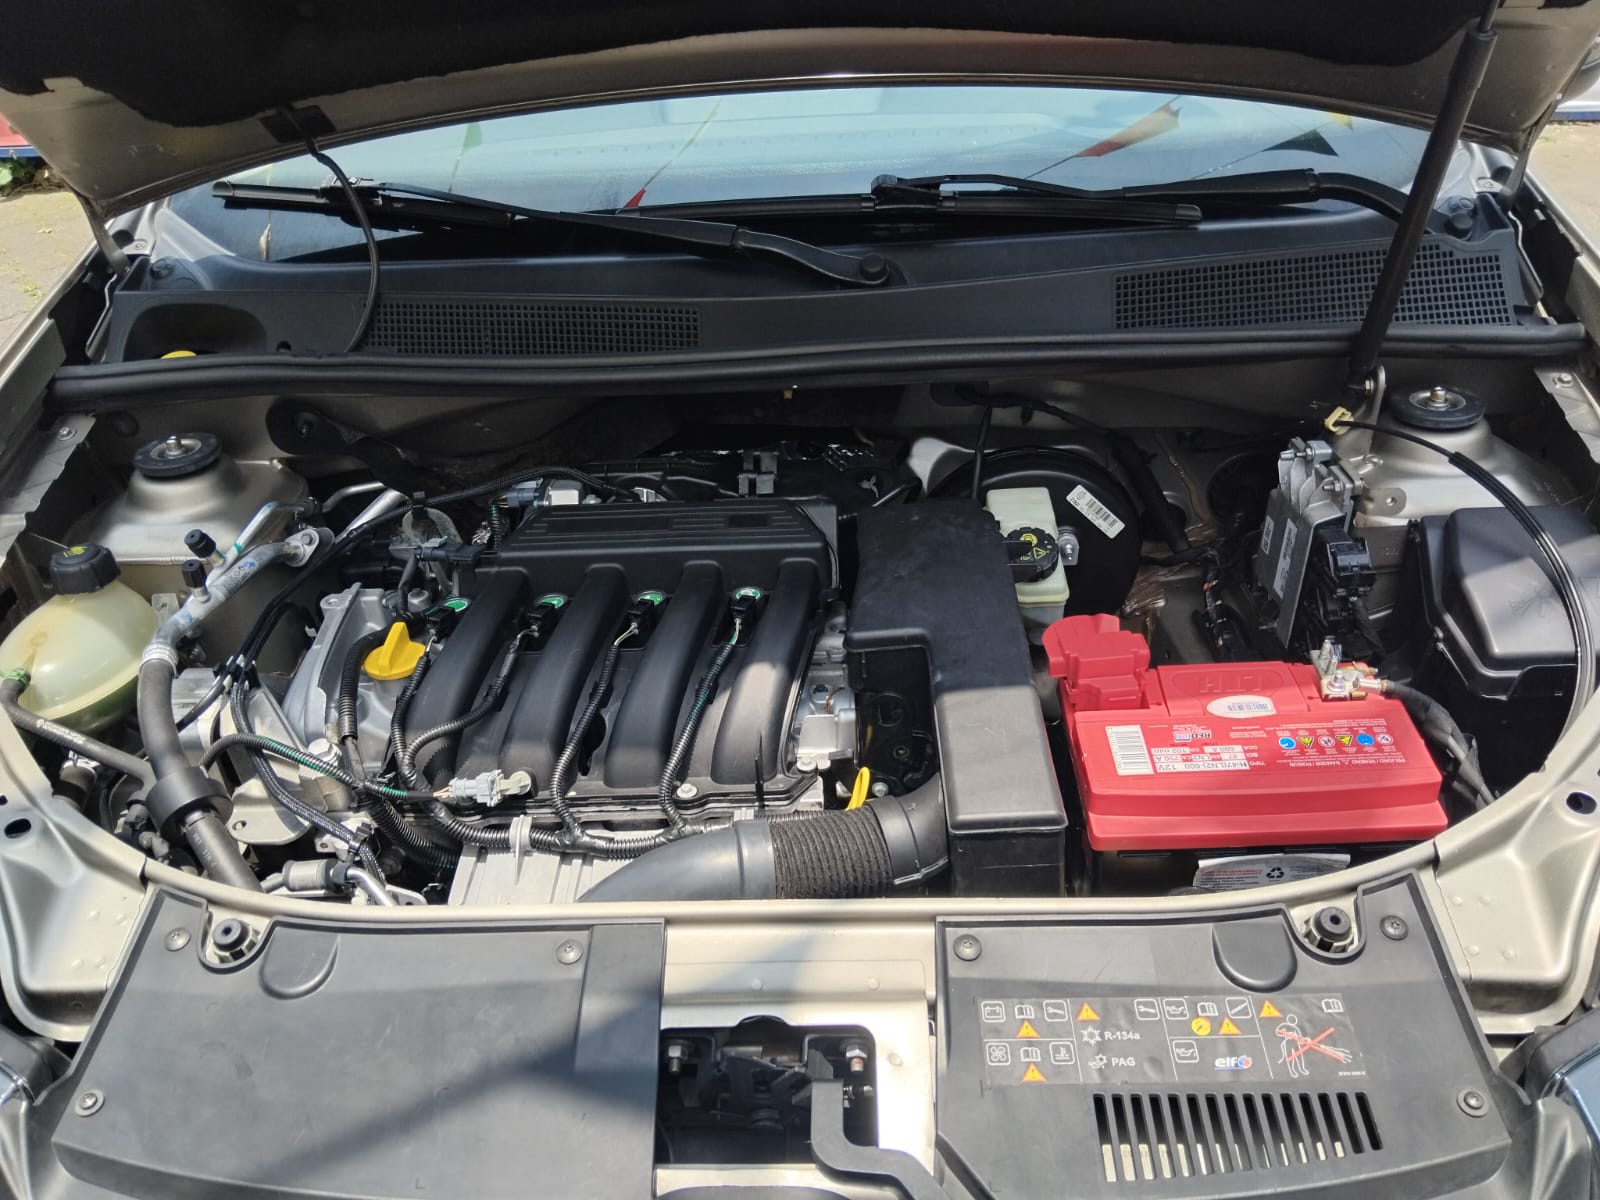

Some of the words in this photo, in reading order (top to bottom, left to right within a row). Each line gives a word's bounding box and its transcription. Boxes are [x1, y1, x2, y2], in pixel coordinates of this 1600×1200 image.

[1104, 1031, 1141, 1041] R-134a
[1111, 1057, 1136, 1067] PAG
[1214, 1057, 1238, 1068] elf
